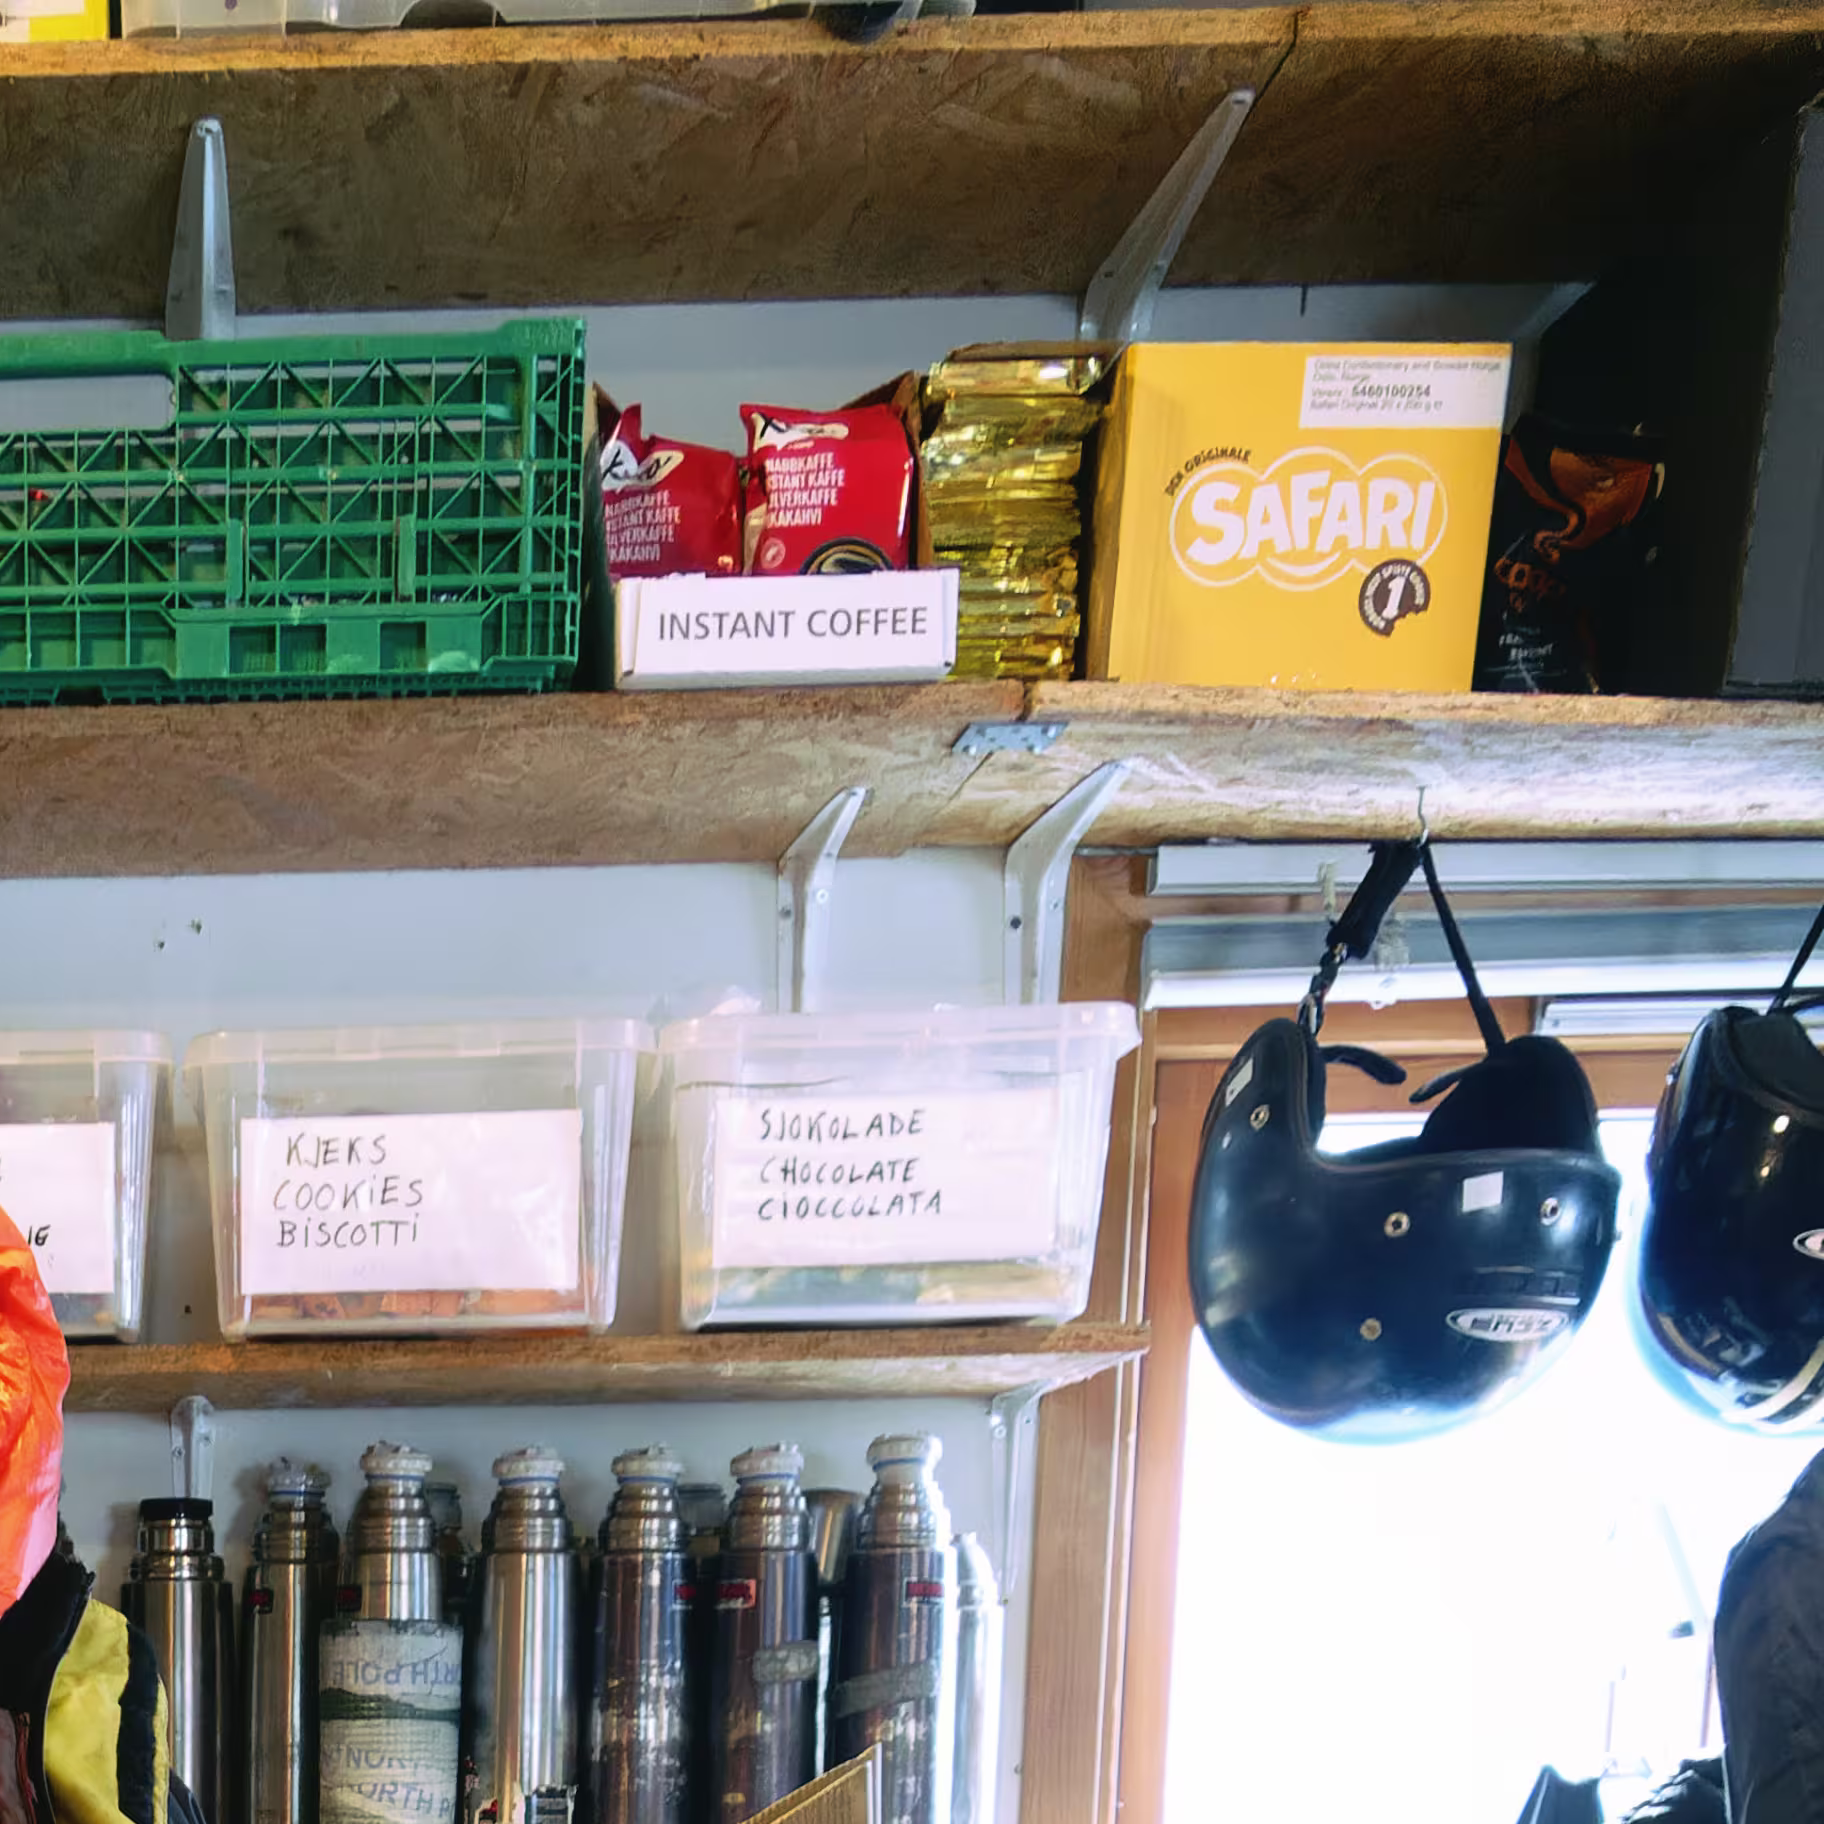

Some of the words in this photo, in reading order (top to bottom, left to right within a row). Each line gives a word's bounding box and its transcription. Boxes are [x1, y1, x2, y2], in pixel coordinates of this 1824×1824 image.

[1184, 446, 1251, 473] ORIGINALE
[808, 468, 845, 488] KAFFE
[1186, 470, 1436, 565] SAFARI
[658, 610, 795, 641] INSTANT
[807, 606, 928, 638] COFFEE
[760, 1108, 926, 1143] SJOKOLADE
[286, 1132, 387, 1169] KJEKS
[760, 1155, 919, 1186] CHOCOLATE
